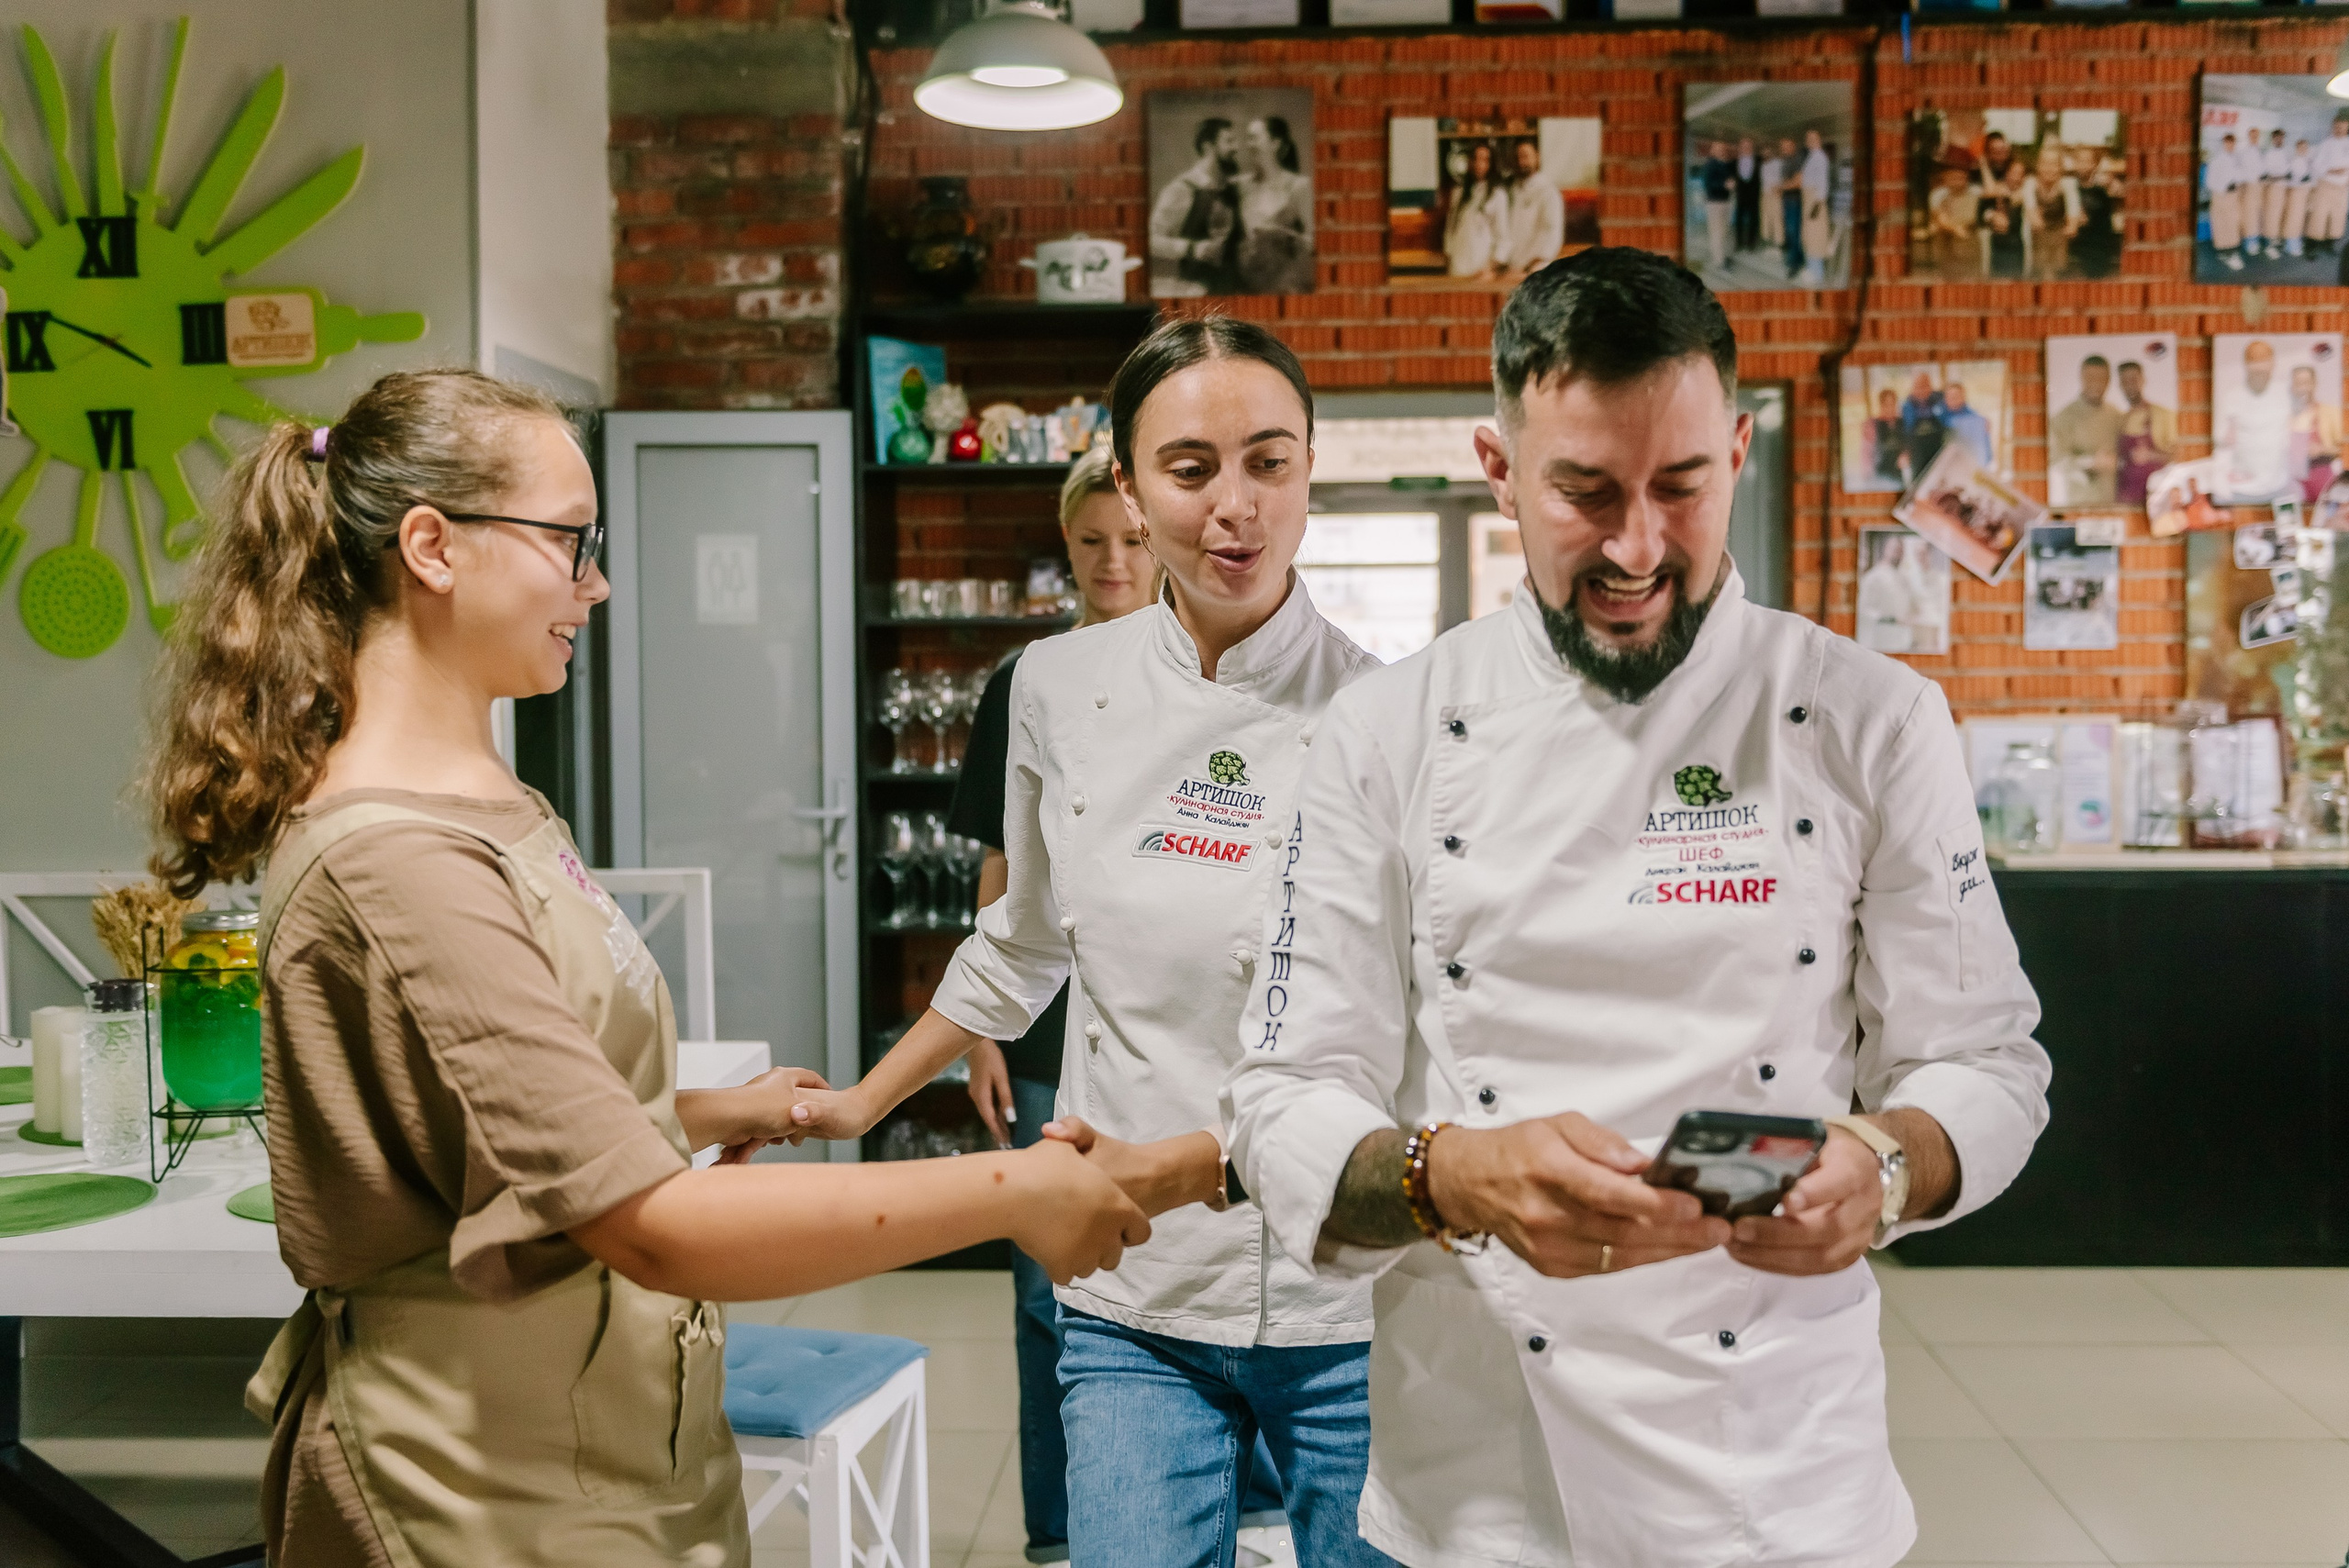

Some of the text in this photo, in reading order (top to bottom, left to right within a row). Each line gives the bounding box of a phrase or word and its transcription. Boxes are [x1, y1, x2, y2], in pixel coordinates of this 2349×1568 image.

[76, 216, 139, 278] XII
[6, 311, 57, 372] IX
[86, 409, 136, 471] VI
[1176, 779, 1265, 811] АРТИШОК
[1176, 807, 1199, 819] Анна
[1644, 805, 1758, 832] АРТИШОК
[1162, 833, 1252, 862] SCHARF
[1679, 847, 1723, 862] ШЕФ
[1656, 879, 1776, 904] SCHARF
